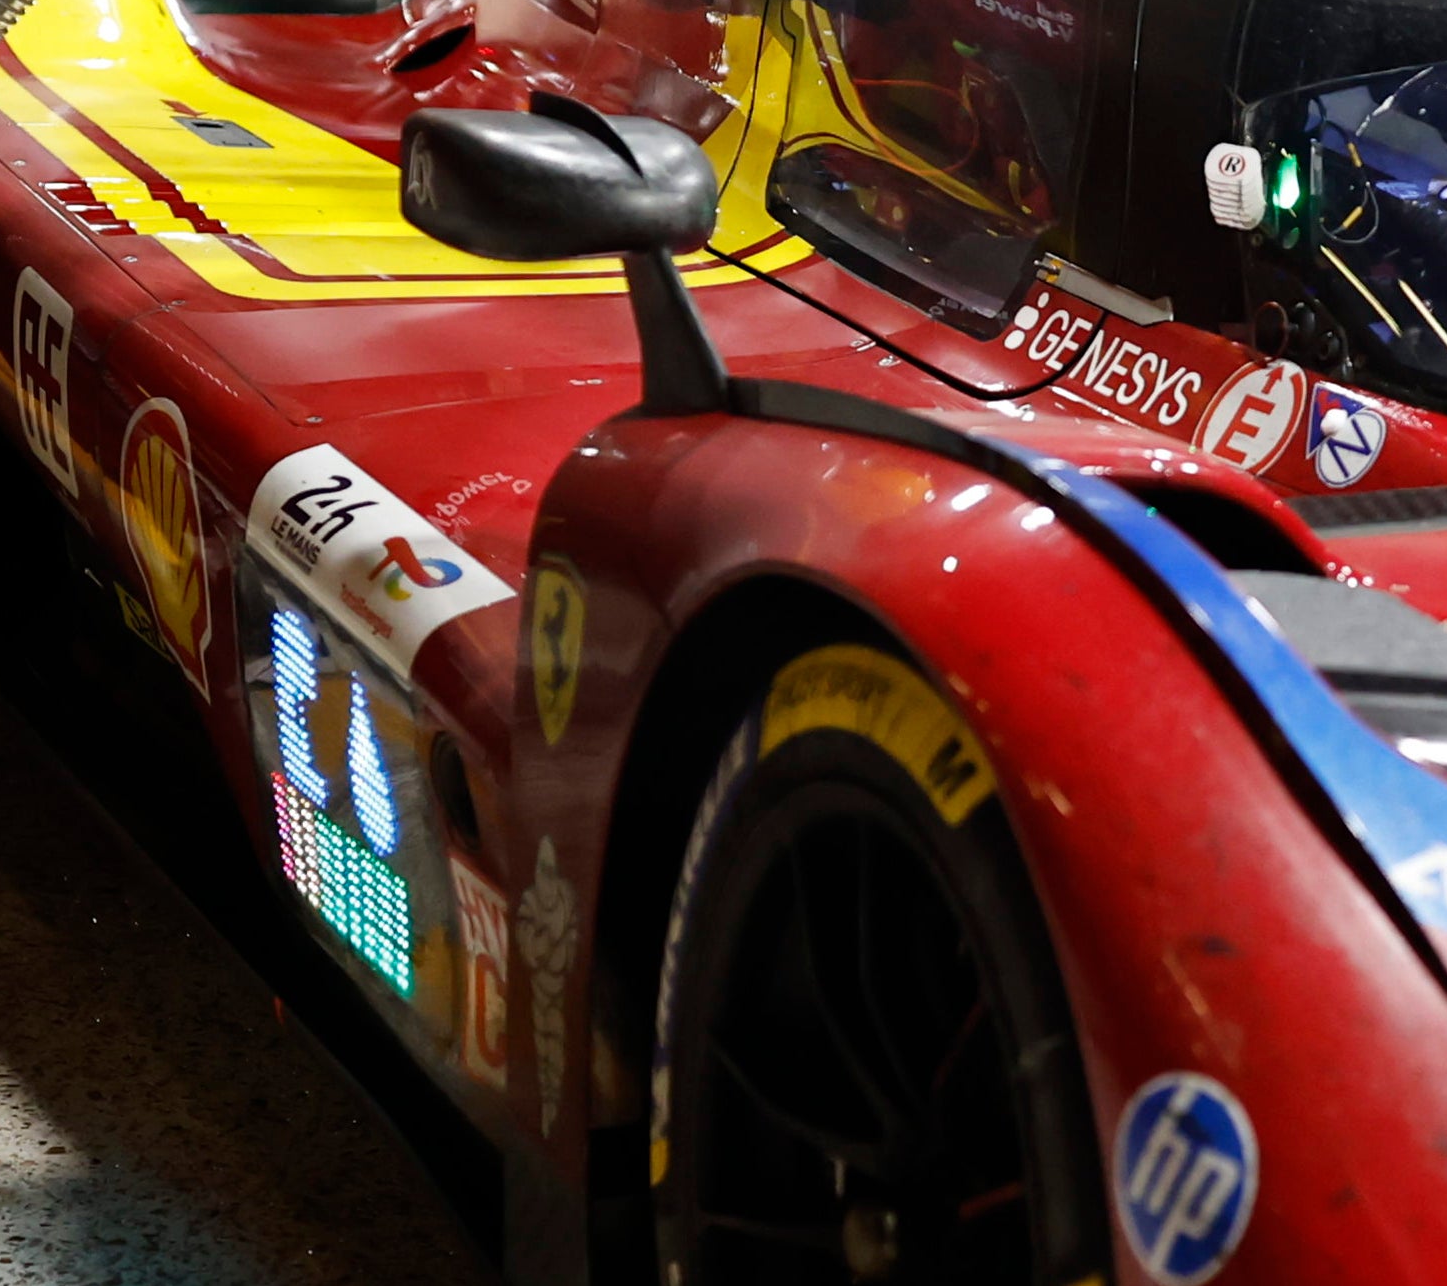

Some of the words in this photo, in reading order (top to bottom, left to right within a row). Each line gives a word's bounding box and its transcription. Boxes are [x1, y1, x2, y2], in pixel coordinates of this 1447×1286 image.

[1027, 309, 1202, 427] GENESYS
[1211, 392, 1276, 466] E
[269, 514, 289, 540] LE
[287, 524, 322, 563] MANS
[280, 474, 380, 545] 24h
[1125, 1076, 1245, 1284] hp
